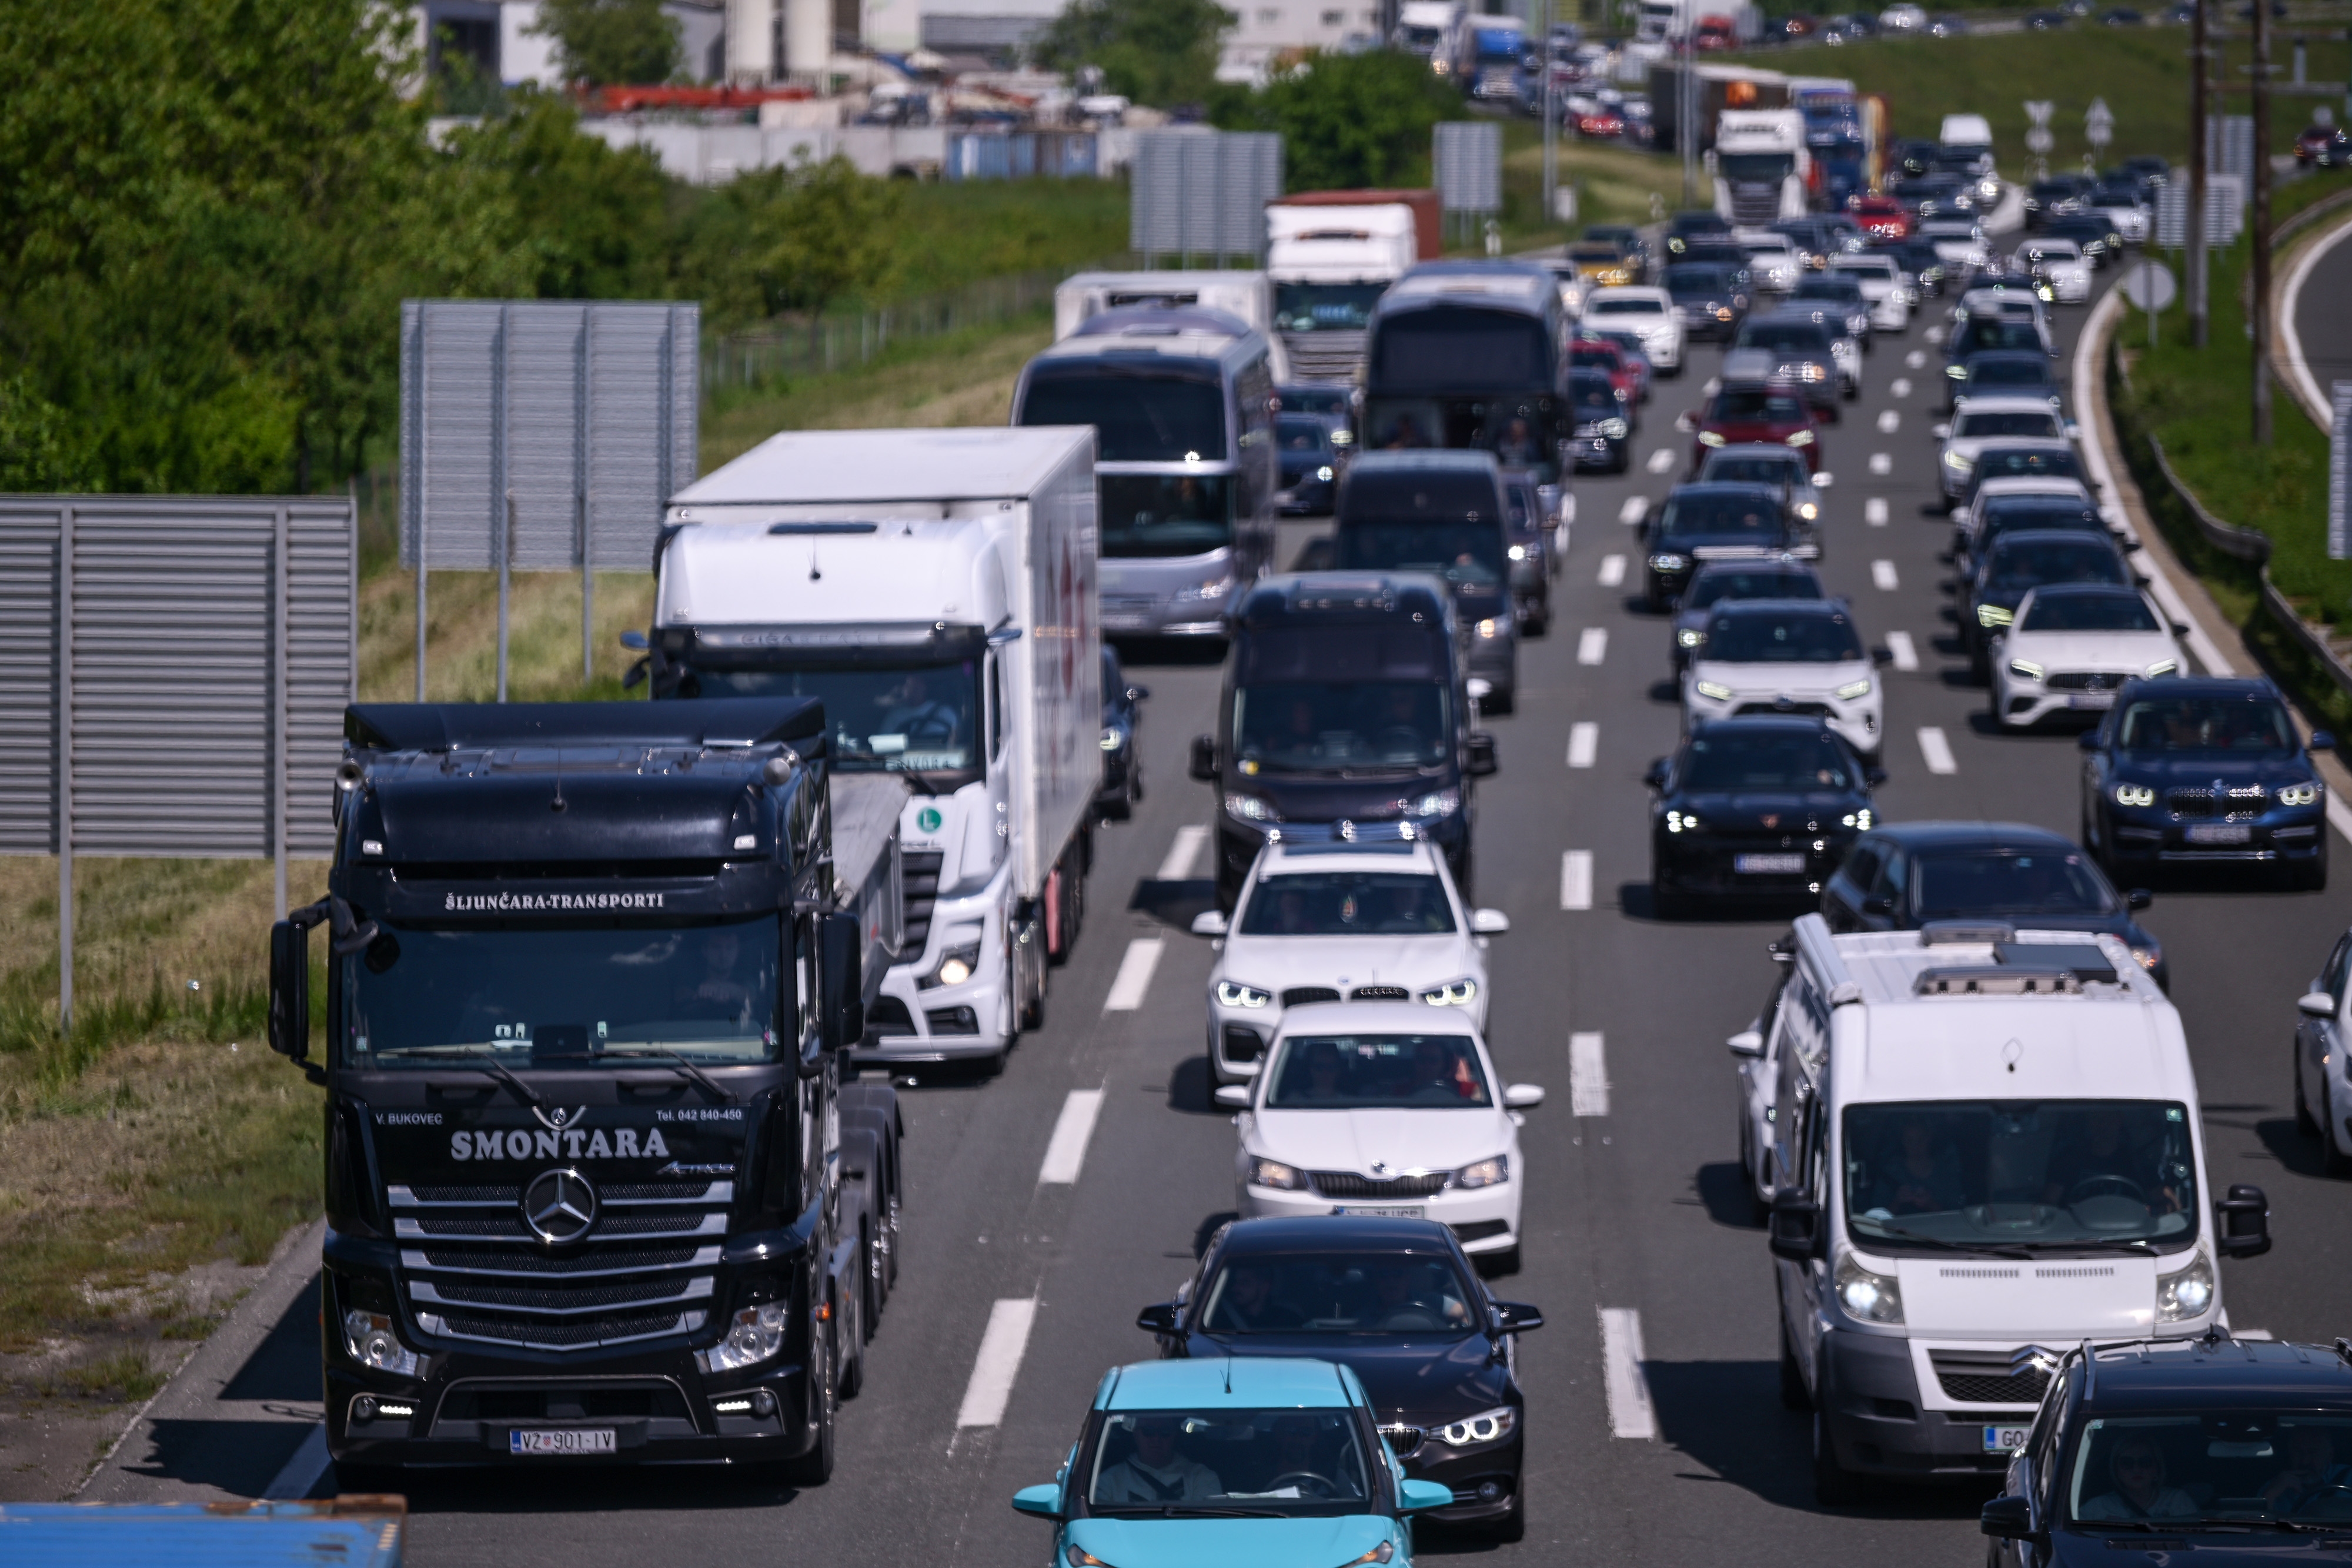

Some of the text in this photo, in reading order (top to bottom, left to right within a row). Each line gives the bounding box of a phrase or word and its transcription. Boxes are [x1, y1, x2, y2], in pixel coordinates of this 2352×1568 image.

[445, 891, 664, 910] ŠLJUNČARA-TRANSPORTI
[388, 1113, 443, 1125] BUKOVEC
[656, 1108, 742, 1122] Tel. 042 840-450
[450, 1127, 670, 1161] SMONTARA
[523, 1431, 612, 1449] VŽ 901-IV
